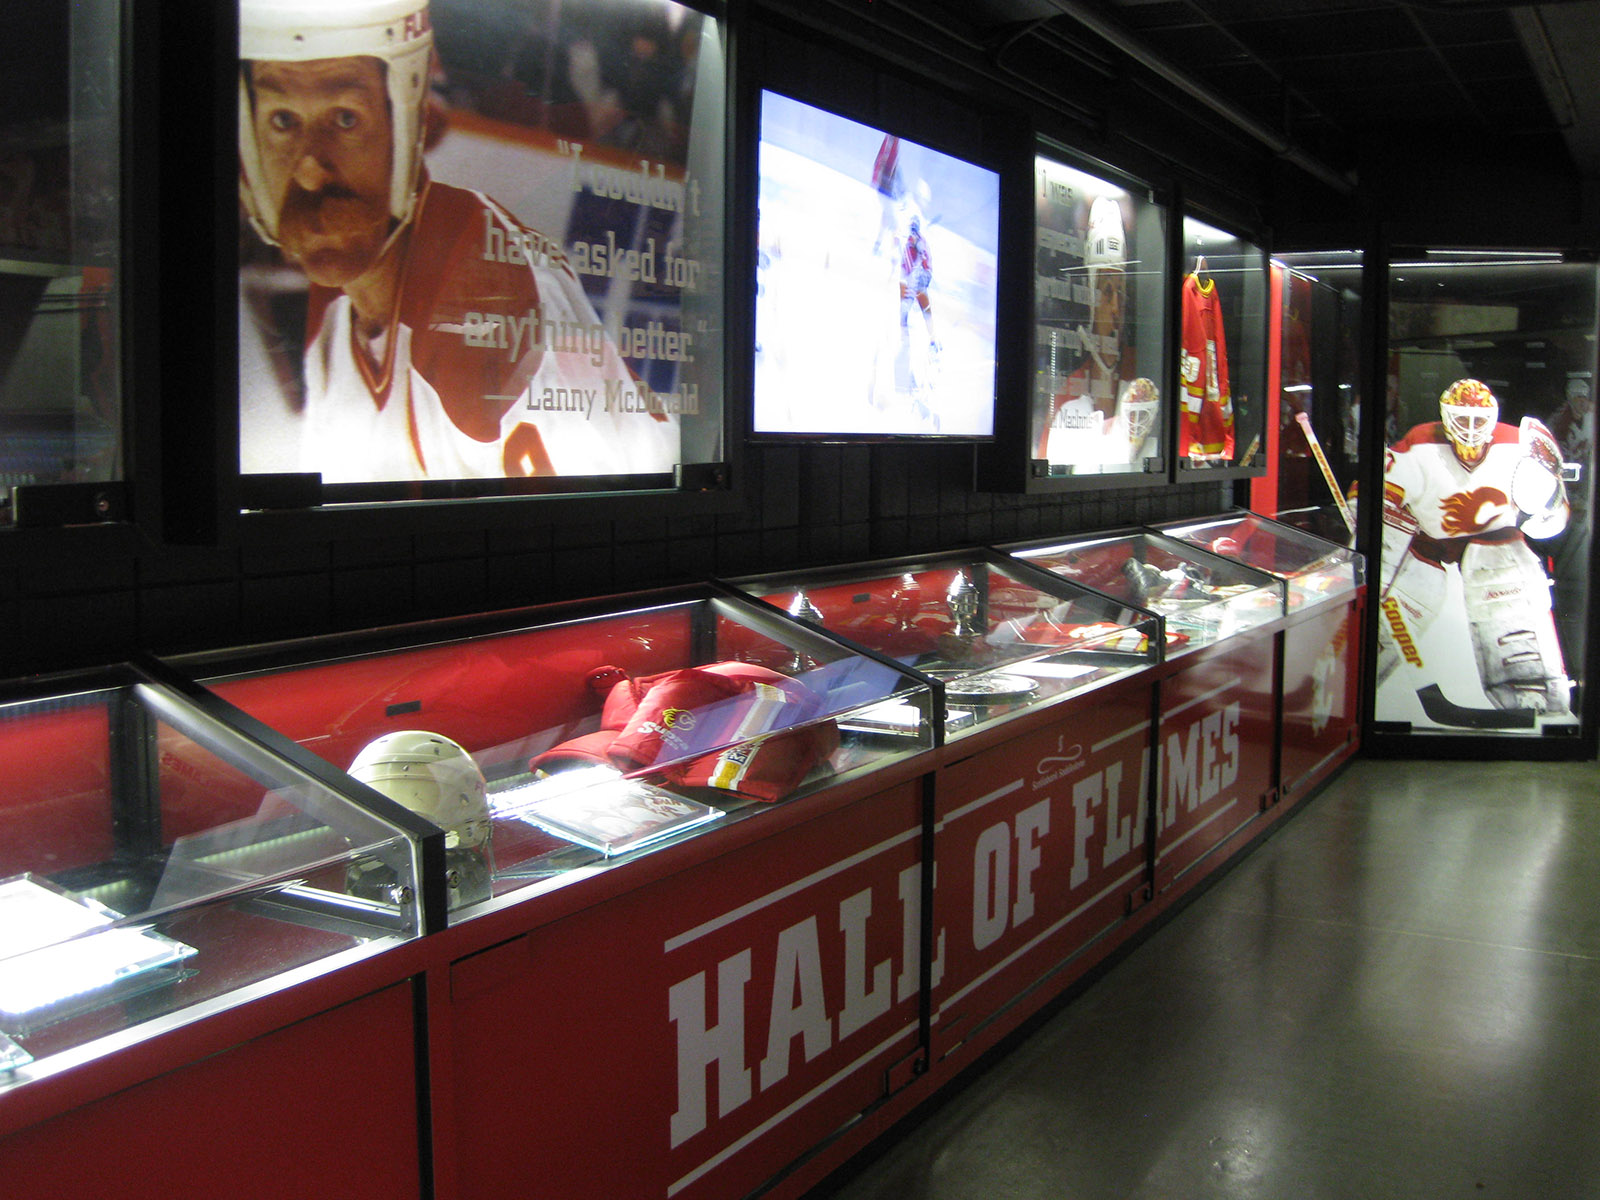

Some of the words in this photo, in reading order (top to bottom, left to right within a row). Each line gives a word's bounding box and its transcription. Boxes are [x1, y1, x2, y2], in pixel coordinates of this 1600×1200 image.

[483, 208, 566, 271] have
[573, 230, 657, 285] asked
[664, 239, 700, 293] for
[464, 308, 606, 368] anything
[526, 373, 597, 421] Lanny
[604, 377, 700, 415] McDonald
[1381, 596, 1424, 669] Cooper
[637, 720, 689, 751] Supra
[668, 861, 946, 1150] HALL
[972, 797, 1051, 951] OF
[1069, 700, 1241, 891] FLAMES
